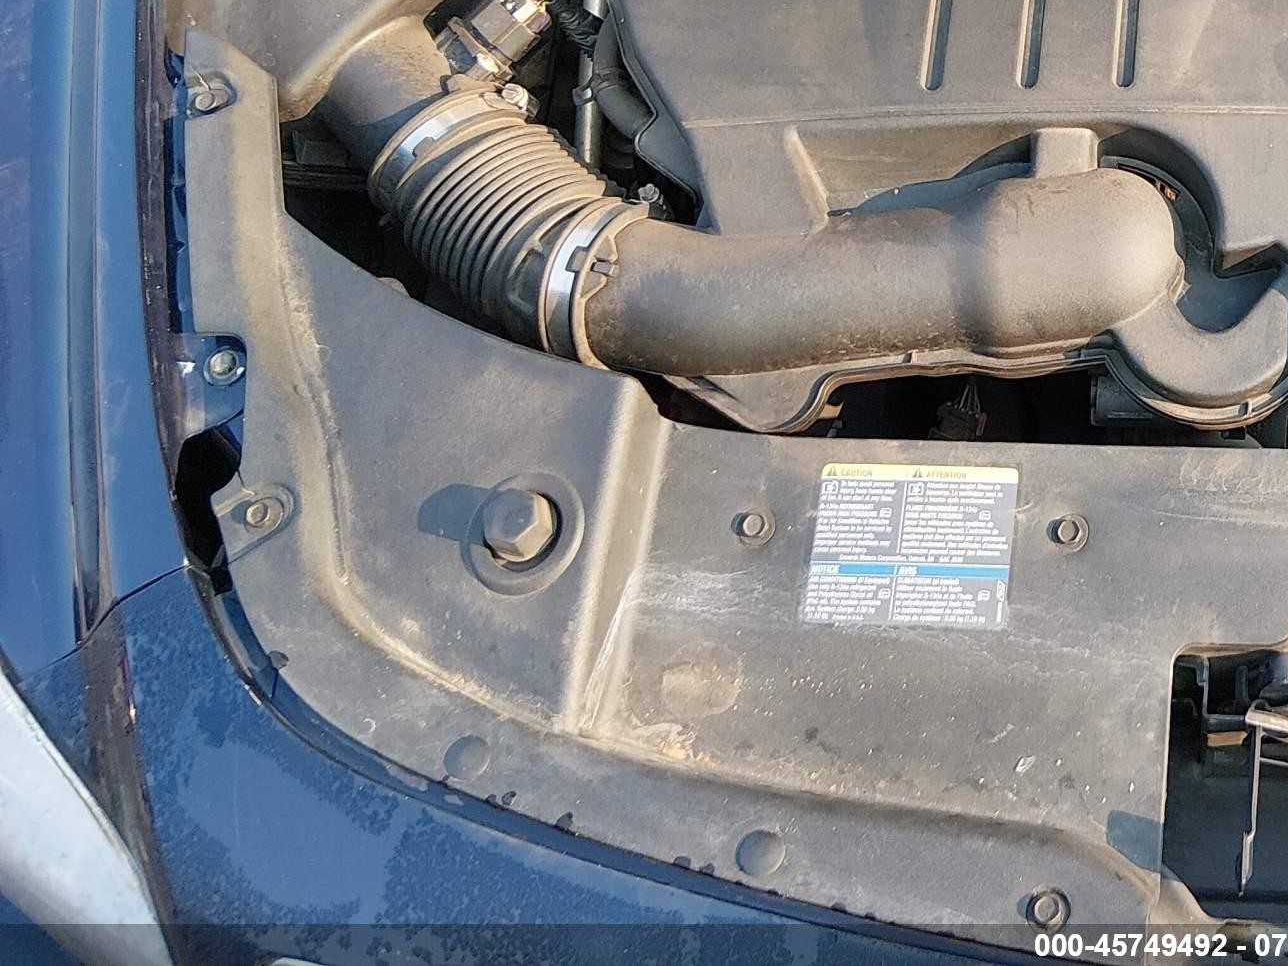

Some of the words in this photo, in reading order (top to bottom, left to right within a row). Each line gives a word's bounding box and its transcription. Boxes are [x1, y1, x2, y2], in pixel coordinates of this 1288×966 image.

[840, 469, 873, 477] CAUTION
[926, 471, 967, 479] ATTENTION
[811, 564, 840, 574] NOTICE
[898, 566, 918, 575] AVIS
